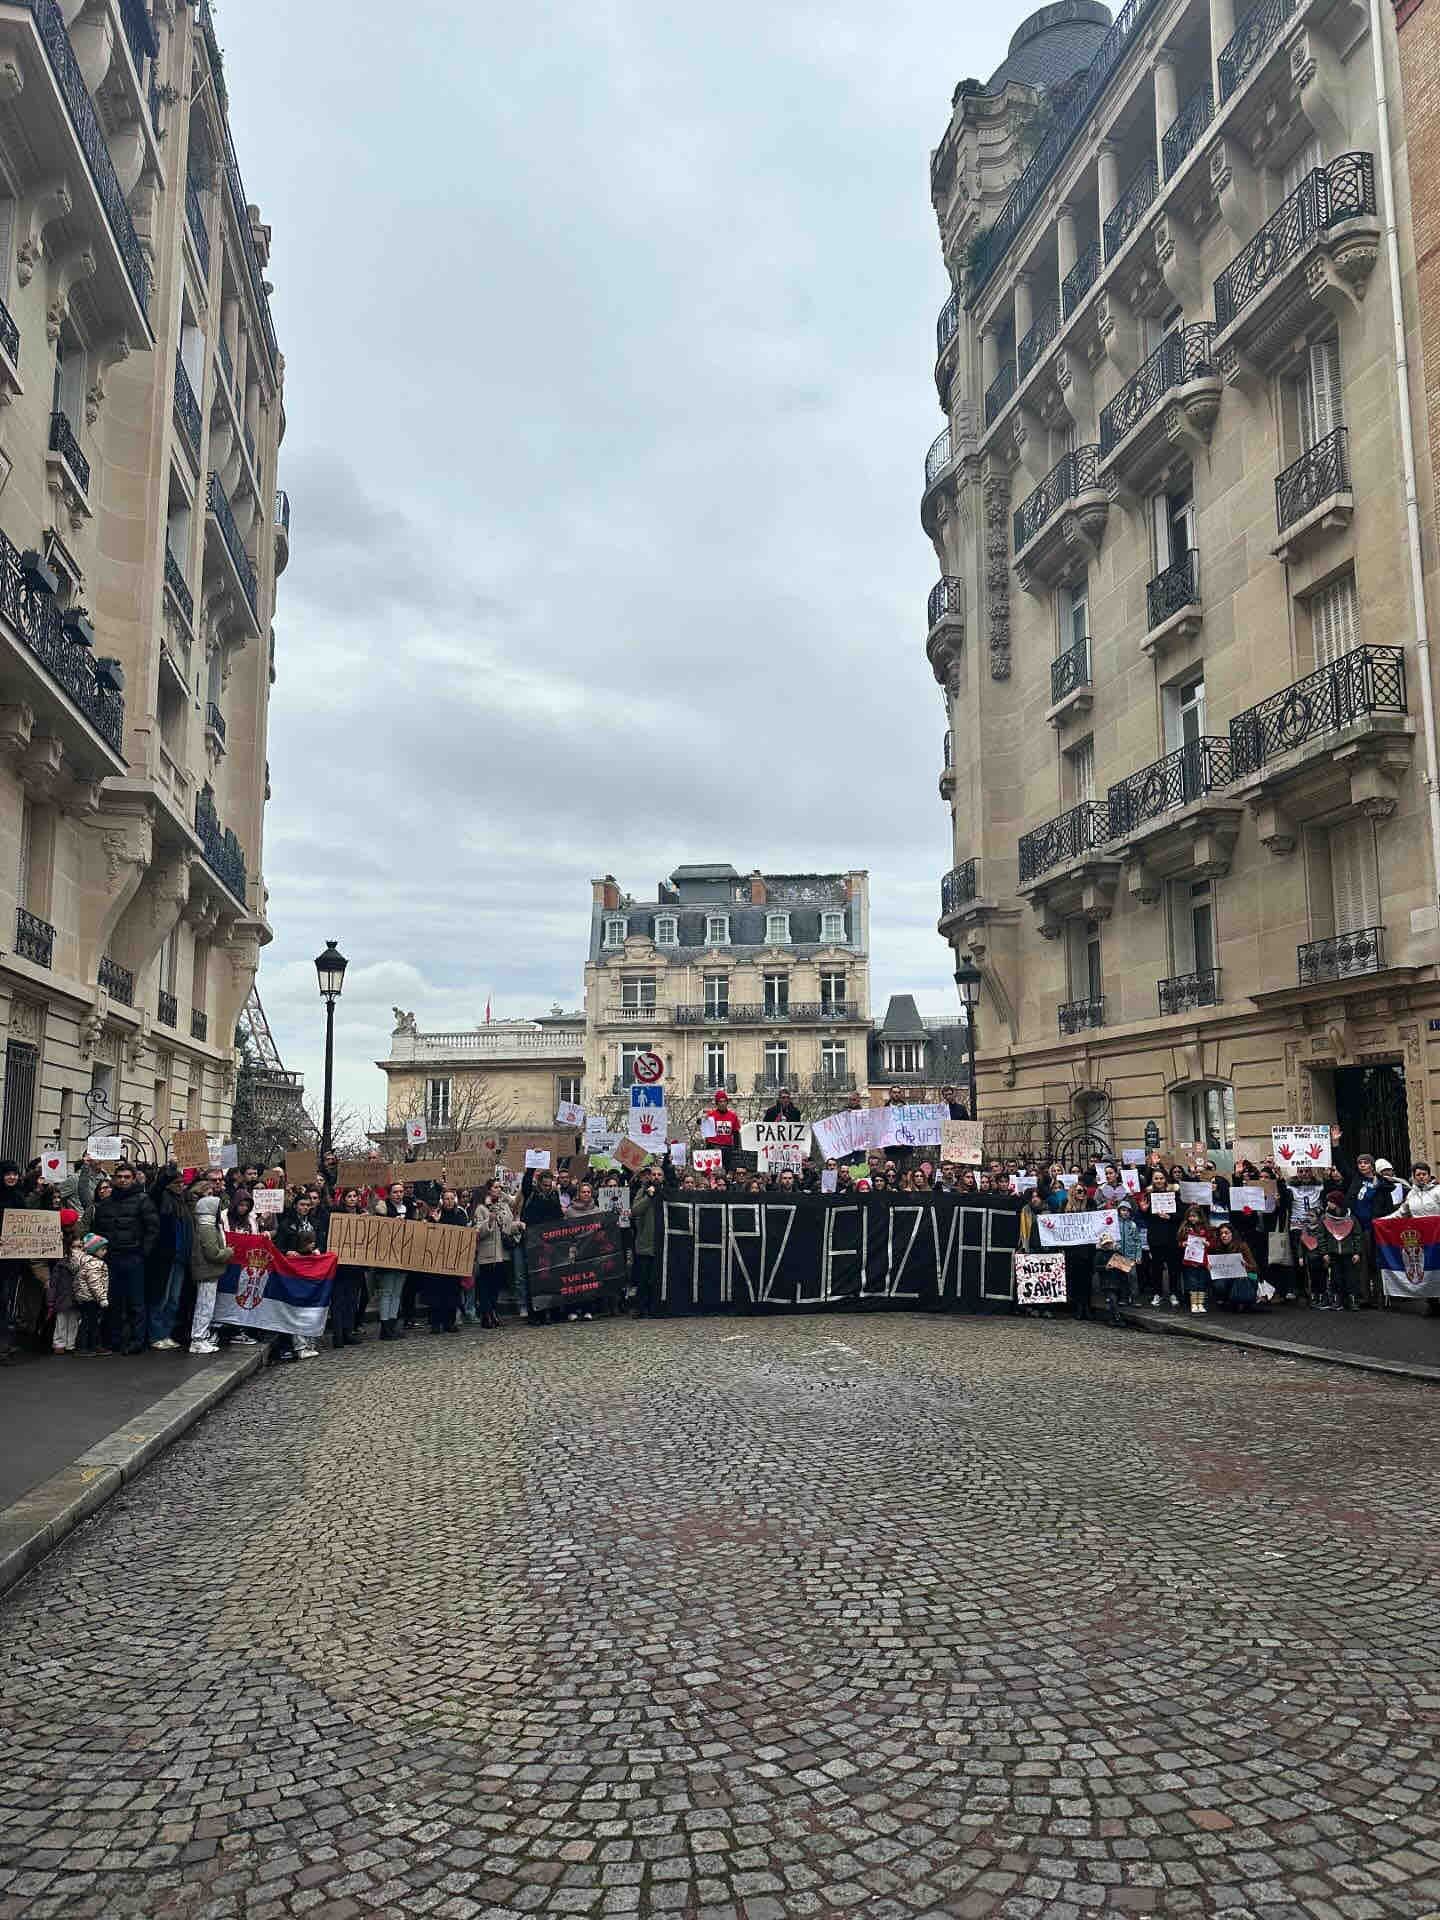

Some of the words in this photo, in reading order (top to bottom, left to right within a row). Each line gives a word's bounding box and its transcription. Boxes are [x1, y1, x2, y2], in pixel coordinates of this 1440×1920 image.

[892, 1106, 937, 1121] SILENCE
[756, 1124, 805, 1141] PARIZ
[330, 1218, 415, 1264] ПАРИСКИ
[661, 1199, 797, 1303] PARIZ
[796, 1205, 858, 1303] JE
[859, 1206, 923, 1297] UZ
[930, 1206, 1016, 1300] VAS
